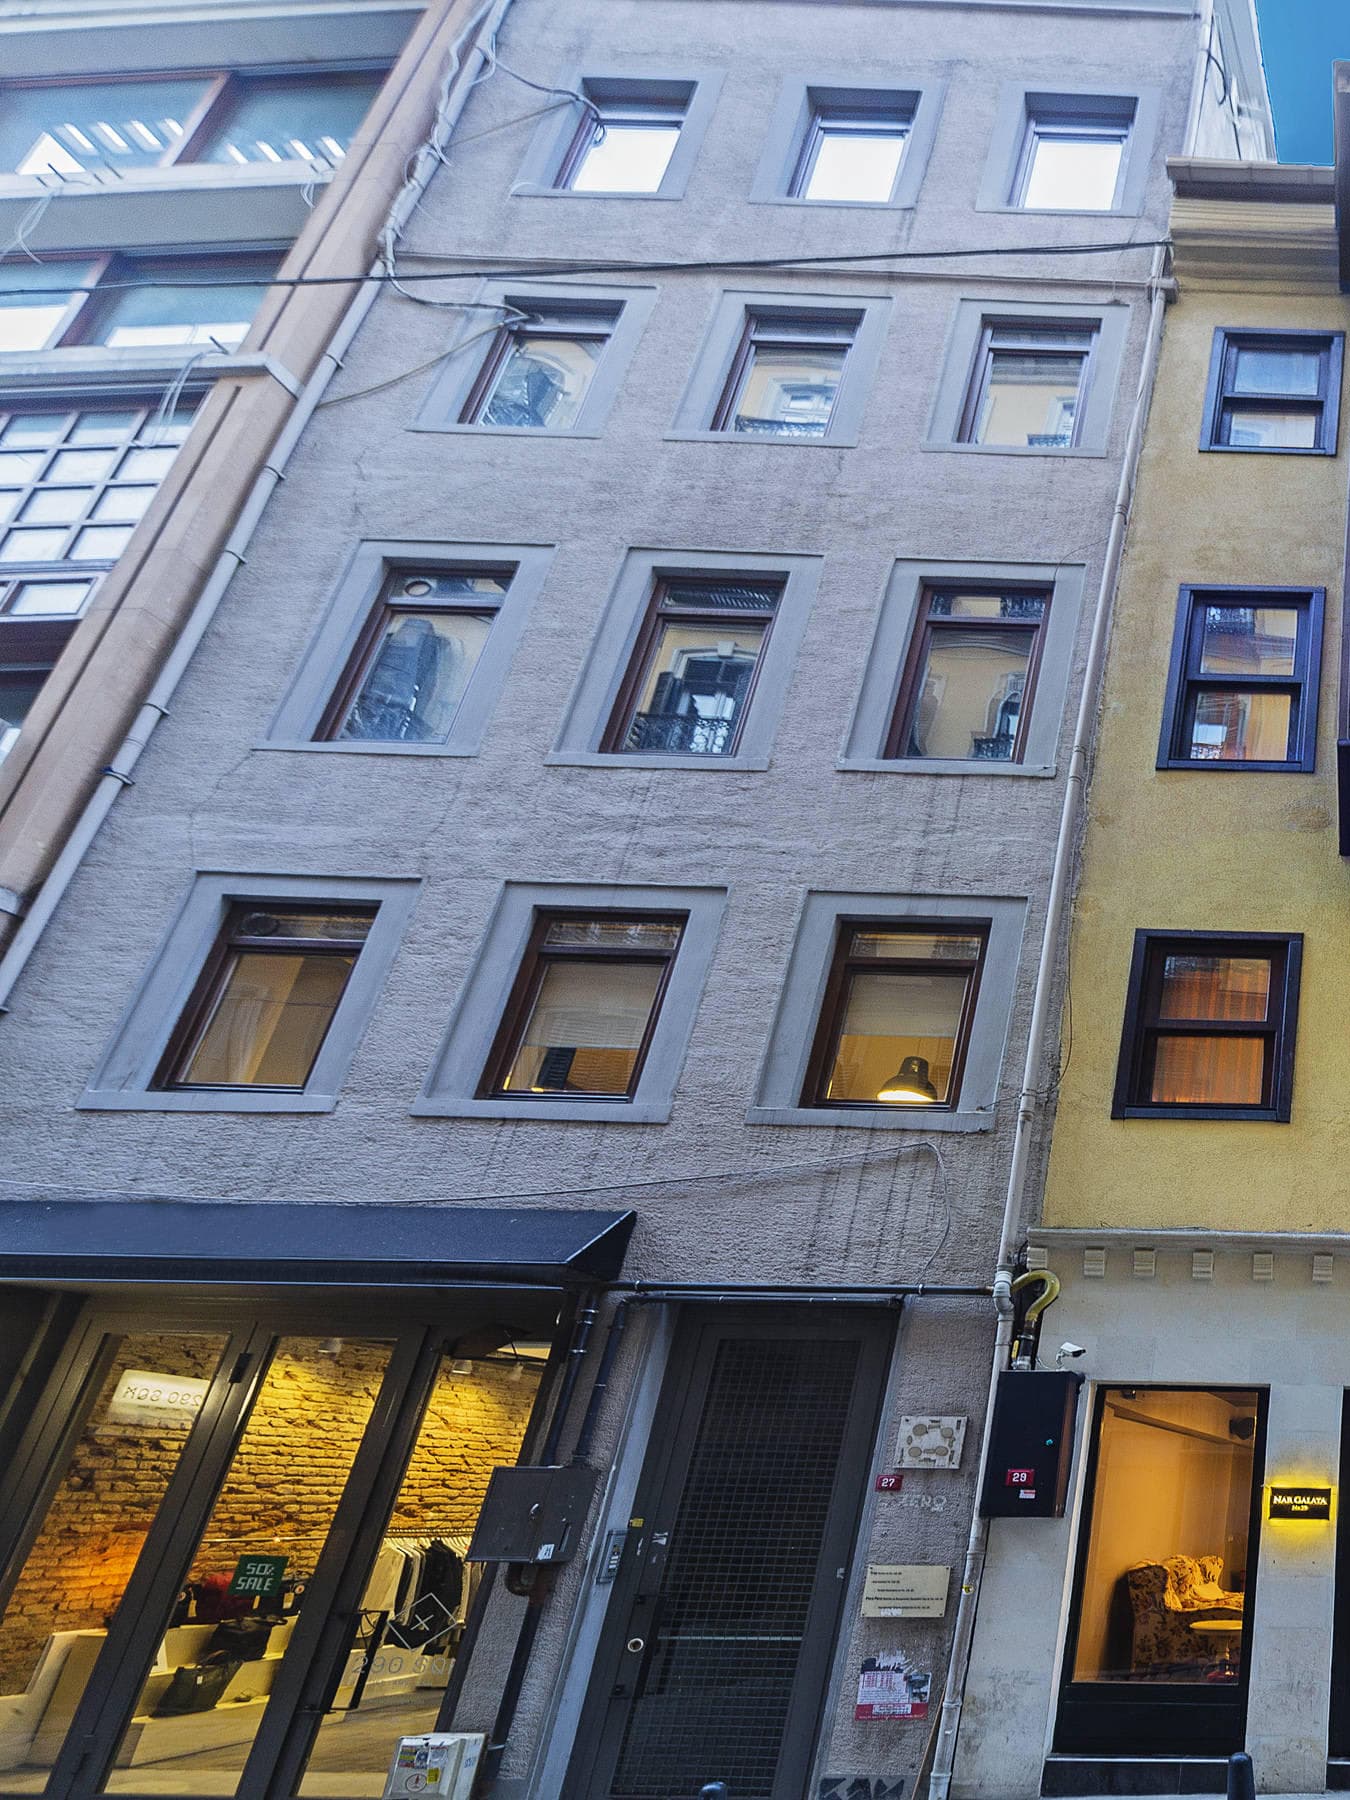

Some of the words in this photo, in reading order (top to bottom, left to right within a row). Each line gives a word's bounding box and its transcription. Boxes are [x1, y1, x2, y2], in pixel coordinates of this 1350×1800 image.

[881, 1478, 895, 1488] 27
[1012, 1472, 1027, 1482] 29
[246, 1562, 275, 1576] 50%
[235, 1576, 273, 1591] SALE
[351, 1655, 403, 1674] 290
[412, 1654, 457, 1675] SQ
